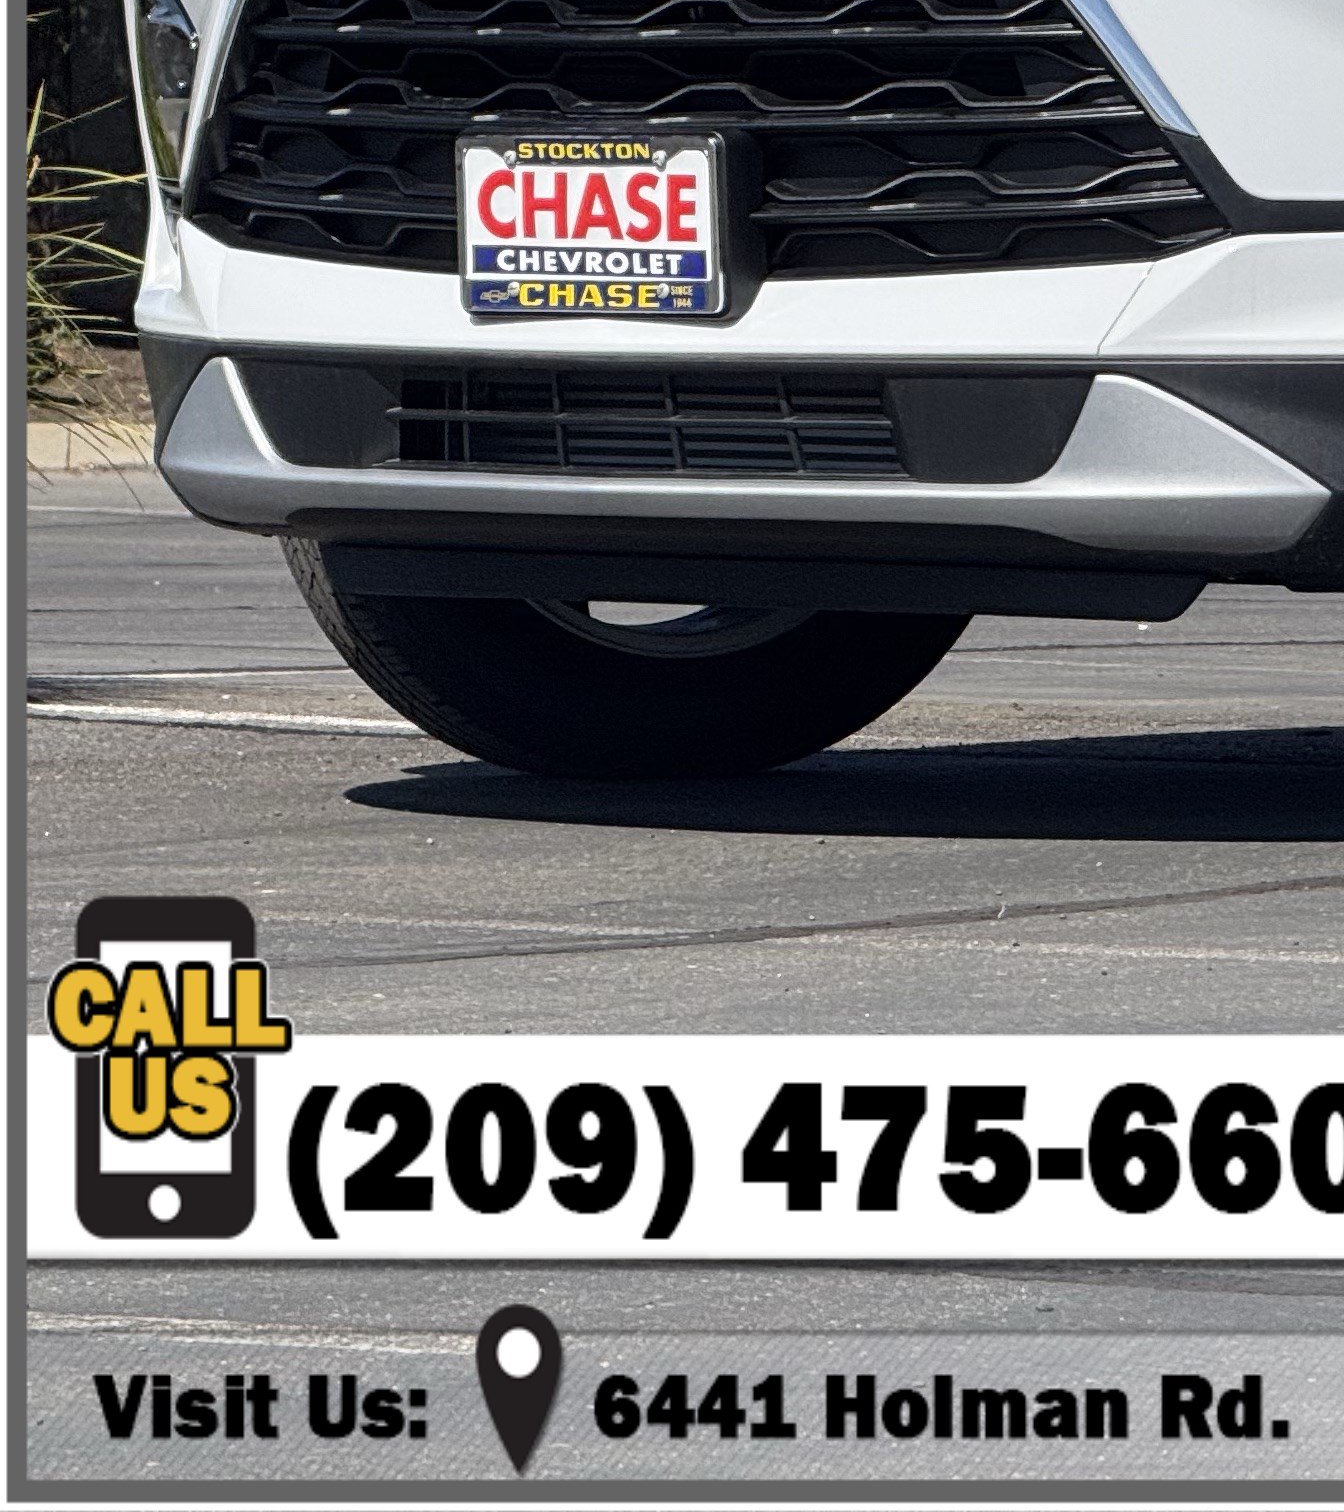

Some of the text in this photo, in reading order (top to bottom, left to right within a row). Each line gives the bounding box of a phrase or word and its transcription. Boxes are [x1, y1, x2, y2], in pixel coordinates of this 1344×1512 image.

[517, 142, 651, 161] STOCKTON
[477, 169, 698, 243] CHASE
[496, 249, 683, 276] CHEVROLET
[518, 283, 661, 309] CHASE
